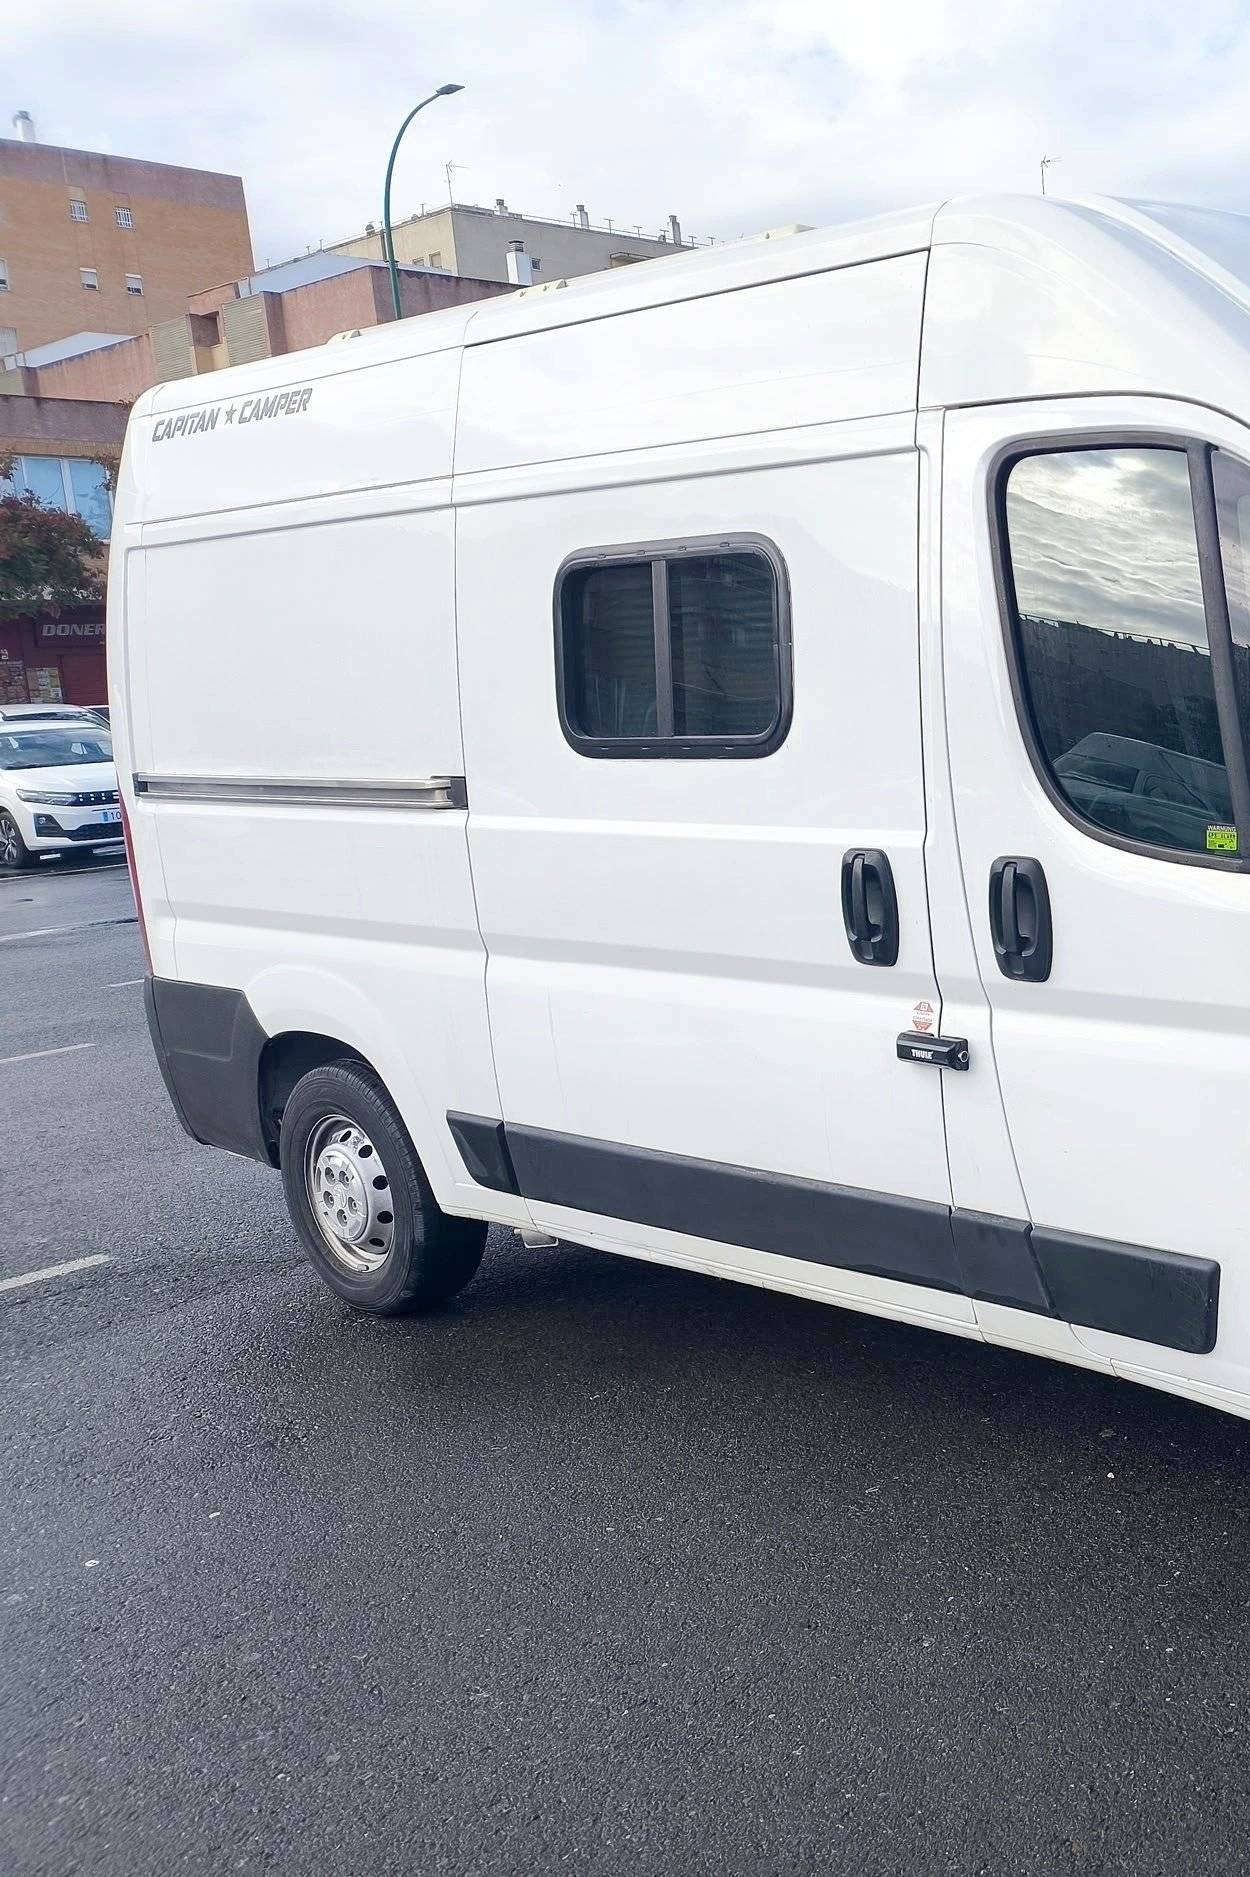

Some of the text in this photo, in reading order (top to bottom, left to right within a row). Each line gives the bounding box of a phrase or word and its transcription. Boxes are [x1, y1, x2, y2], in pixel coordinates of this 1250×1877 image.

[152, 388, 313, 442] CAPITAN CAMPER
[911, 1048, 934, 1060] THULE
